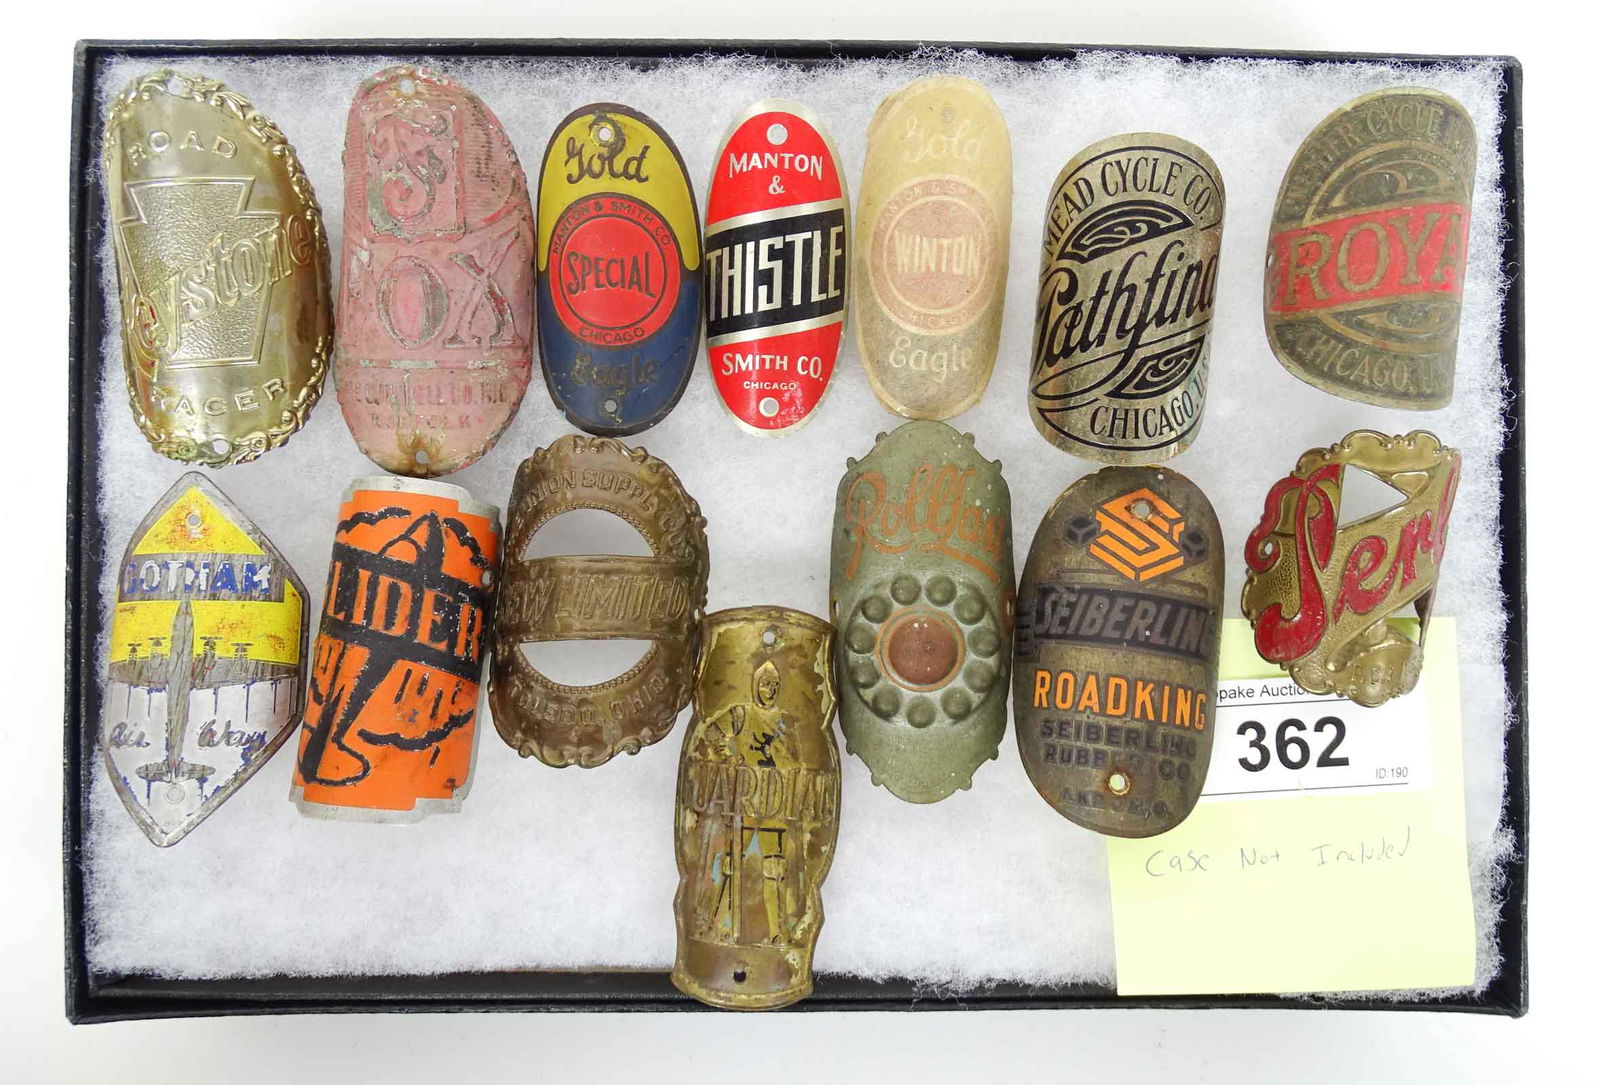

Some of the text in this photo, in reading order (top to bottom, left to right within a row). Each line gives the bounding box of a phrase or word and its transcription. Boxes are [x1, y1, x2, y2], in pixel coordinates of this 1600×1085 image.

[126, 130, 238, 167] ROAD
[565, 137, 650, 184] Gold
[729, 152, 823, 195] MANTON &
[1100, 157, 1184, 199] CYCLE
[1183, 173, 1212, 222] CO.
[610, 201, 655, 225] SMITH
[566, 250, 656, 300] SPECIAL
[706, 225, 845, 321] THISTLE
[894, 228, 984, 280] WINTON
[579, 326, 646, 346] CHICAGO
[570, 351, 660, 397] Eagle
[721, 351, 824, 381] SMITH CO.
[889, 337, 973, 382] Eagle
[150, 376, 287, 419] RACER
[743, 380, 798, 391] CHICAGO
[122, 560, 272, 594] GOTHAM
[1033, 670, 1208, 731] ROADKING
[1260, 682, 1309, 697] Auctio
[1043, 744, 1144, 775] RUBBR
[1236, 716, 1350, 772] 362
[1375, 766, 1409, 780] ID:190
[1240, 848, 1281, 867] Not
